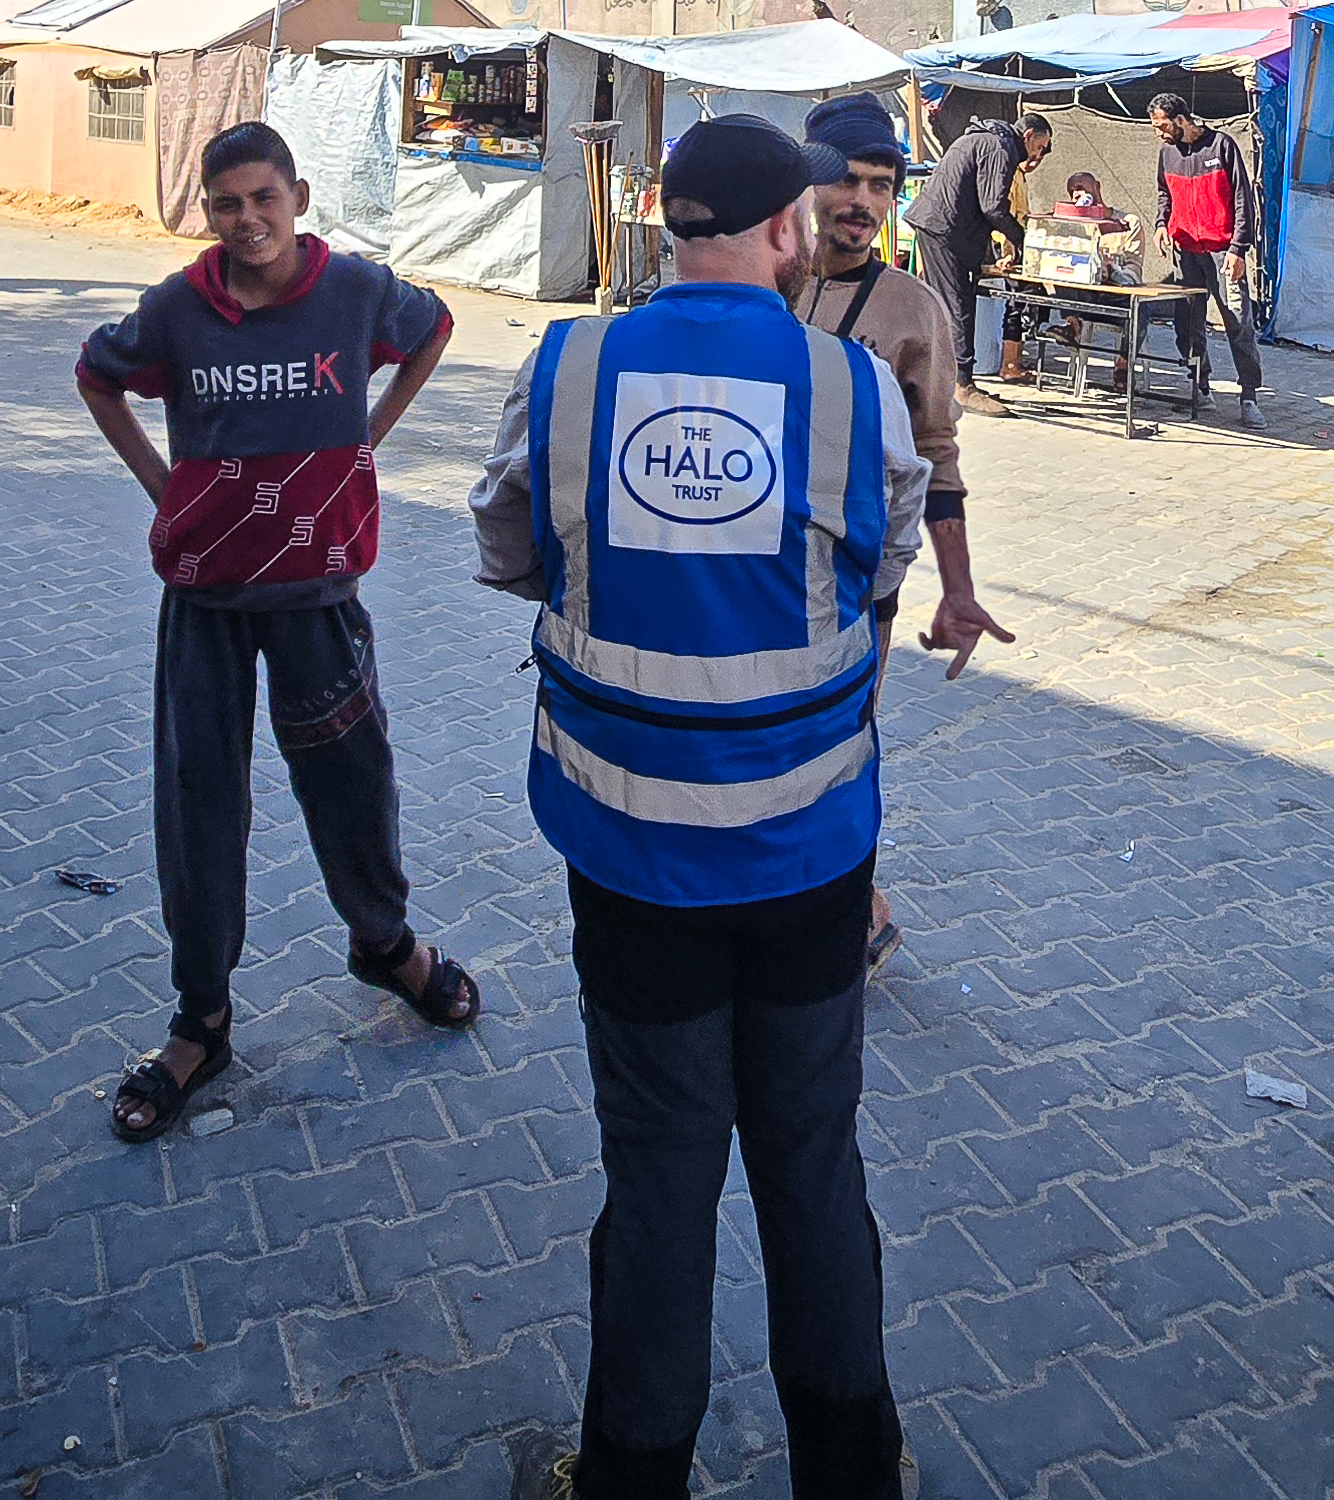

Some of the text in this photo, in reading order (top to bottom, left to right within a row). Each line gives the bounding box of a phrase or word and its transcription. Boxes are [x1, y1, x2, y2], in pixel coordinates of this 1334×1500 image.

[191, 351, 343, 395] DNSREK
[681, 426, 712, 441] THE
[644, 444, 753, 482] HALO
[672, 484, 723, 502] TRUST
